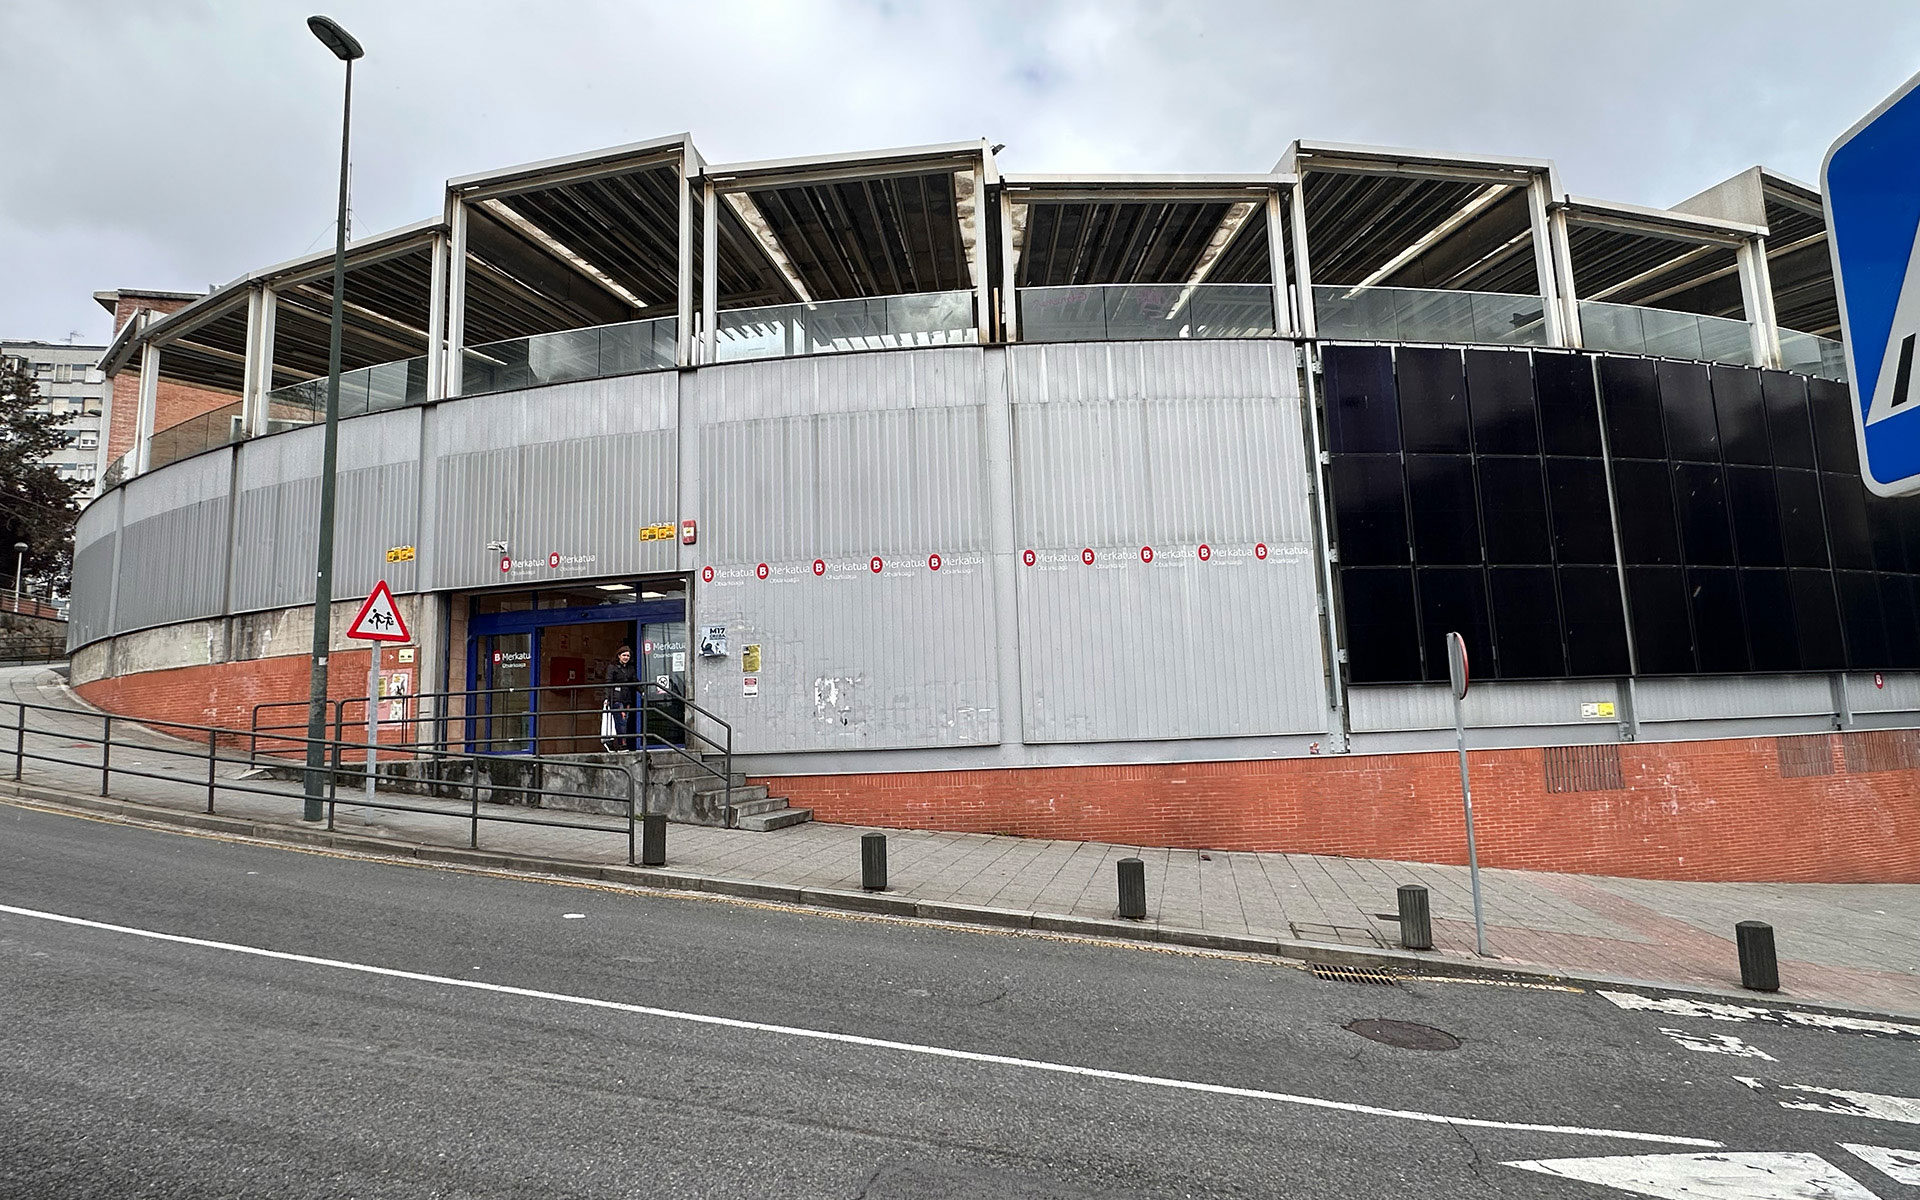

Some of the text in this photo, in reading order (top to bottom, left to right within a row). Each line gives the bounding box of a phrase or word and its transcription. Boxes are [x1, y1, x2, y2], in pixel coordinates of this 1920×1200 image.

[1095, 550, 1137, 561] Merkatua
[1154, 548, 1196, 560] Merkatua
[1211, 546, 1253, 557] Merkatua
[1268, 545, 1309, 556] Merkatua
[560, 554, 596, 564] Merkatua
[941, 555, 985, 567] Merkatua
[1037, 552, 1079, 562] Merkatua
[511, 559, 545, 568] Merkatua
[826, 561, 868, 572] Merkatua
[883, 558, 926, 569] Merkatua
[714, 568, 754, 579] Merkatua
[769, 565, 810, 575] Merkatua
[502, 651, 531, 661] Merkatu
